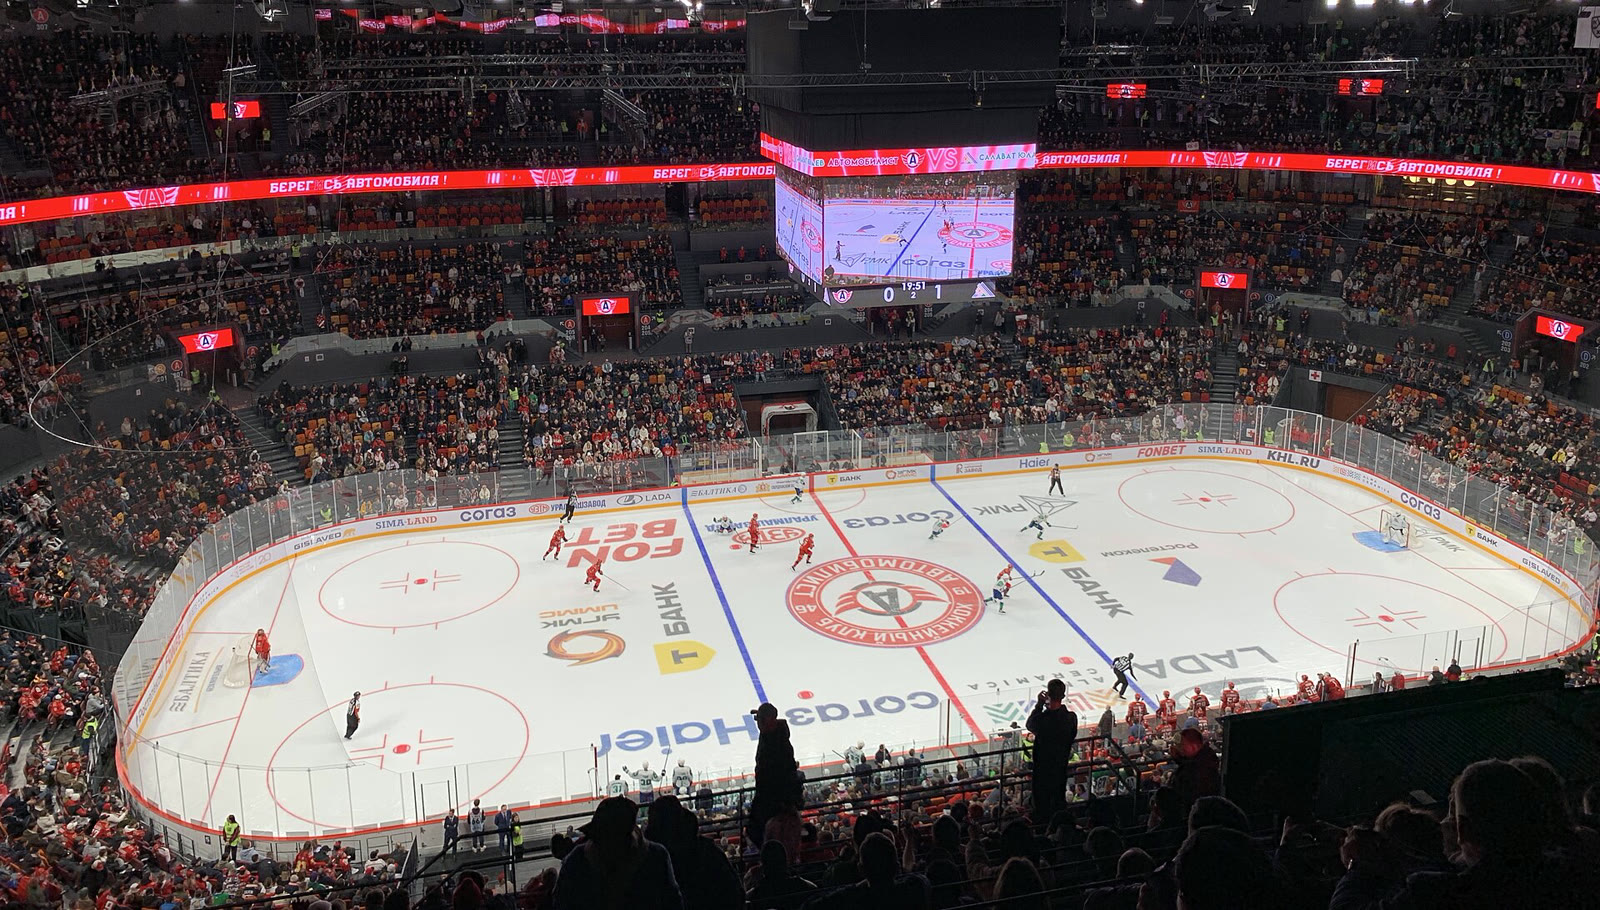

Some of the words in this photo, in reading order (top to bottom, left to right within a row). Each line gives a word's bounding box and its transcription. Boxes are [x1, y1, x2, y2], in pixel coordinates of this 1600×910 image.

[827, 157, 898, 168] АВТОМОБИЛИСТ
[927, 148, 958, 170] VS
[979, 152, 1016, 161] САЛАВАТ
[1042, 154, 1121, 165] АВТОМОБИЛЯ
[1398, 162, 1493, 178] АВТОМОБИЛЯ
[346, 175, 439, 189] АВТОМОБИЛЯ
[902, 255, 966, 269] согаз
[883, 286, 895, 302] 0
[901, 281, 926, 291] 19:51
[935, 284, 942, 299] 1
[910, 291, 916, 299] 2
[1137, 445, 1187, 458] FONBET
[1267, 450, 1321, 469] KHL.RU
[1019, 457, 1050, 469] Haier
[645, 493, 672, 502] LADA
[697, 487, 738, 496] БАЛТИКА
[460, 506, 517, 523] согаз
[972, 502, 1029, 516] РМК
[564, 518, 678, 547] BET
[1477, 531, 1499, 547] БАНК
[1101, 542, 1199, 558] Ростелеком
[1430, 537, 1466, 552] РМК
[566, 538, 684, 568] FON
[794, 557, 957, 598] АВТОМОБИЛИСТ
[1522, 557, 1561, 585] GISLAVED
[1061, 566, 1134, 619] БАНК
[538, 603, 619, 618] UMMC
[651, 581, 691, 637] БАНК
[540, 612, 621, 629] УГМК
[816, 617, 869, 640] КЛУБ
[873, 602, 975, 645] ХОККЕЙНЫЙ
[1132, 645, 1279, 680] LADA
[173, 652, 210, 701] БАЛТИКА
[967, 667, 1098, 691] CERAMICA
[785, 690, 940, 726] согаз
[597, 715, 759, 758] Haier
